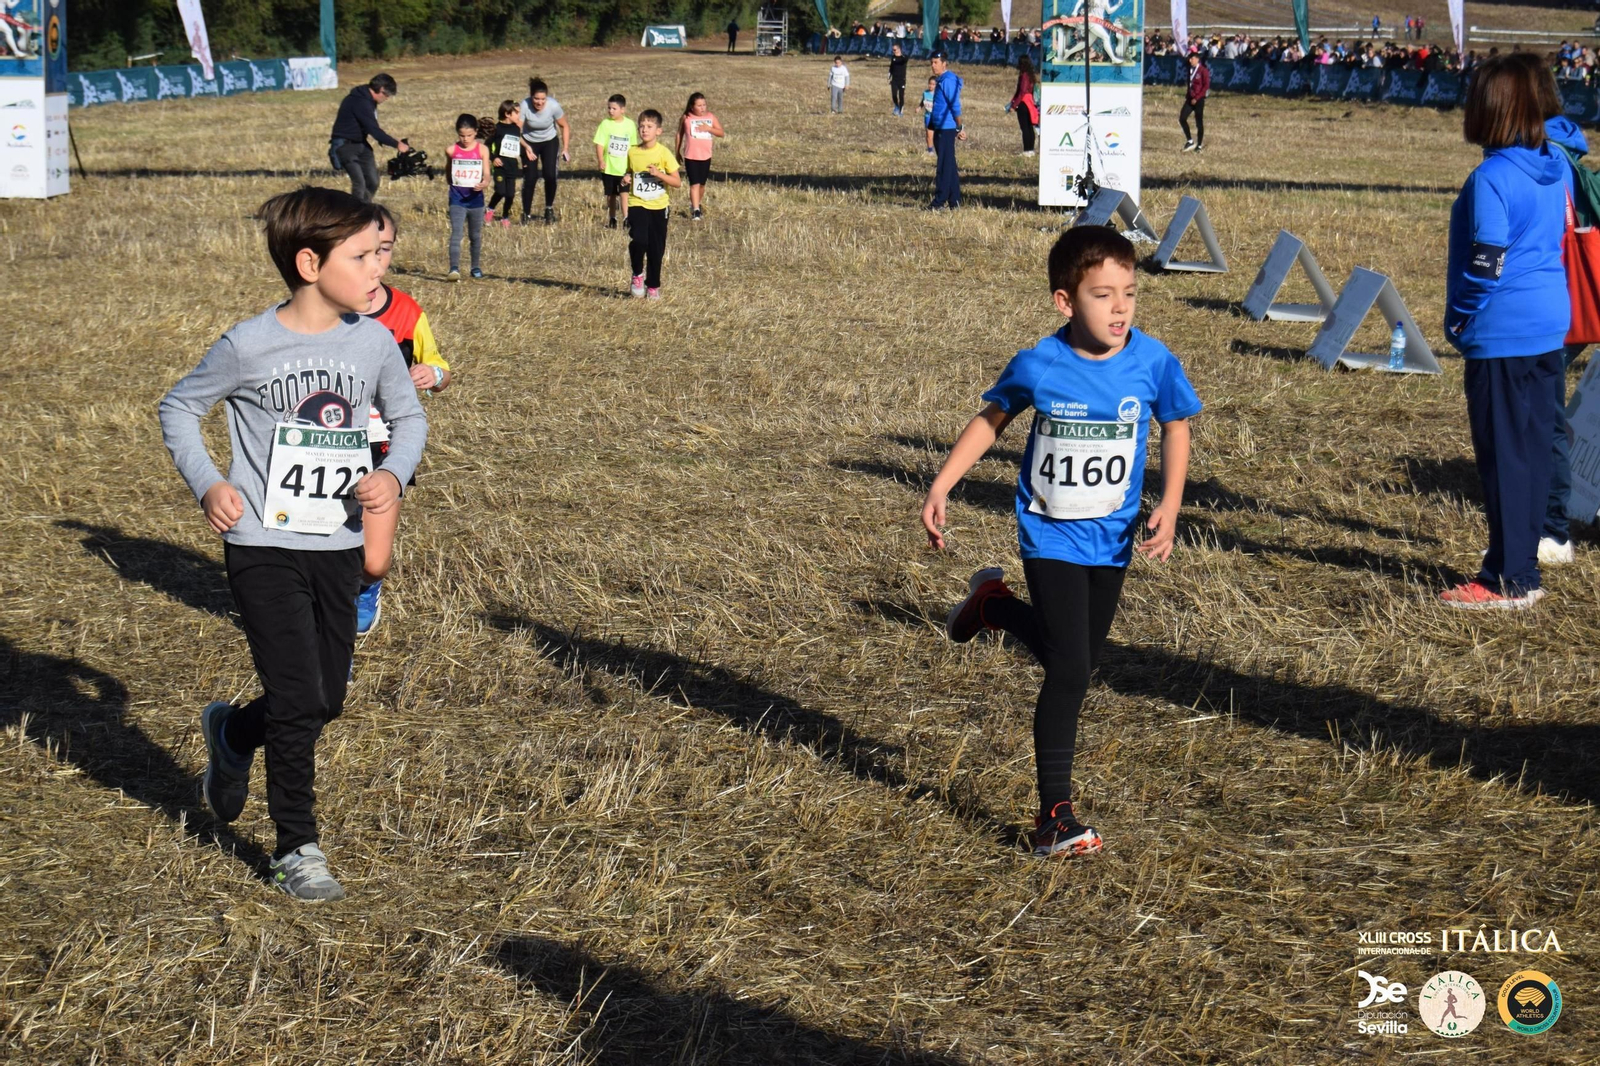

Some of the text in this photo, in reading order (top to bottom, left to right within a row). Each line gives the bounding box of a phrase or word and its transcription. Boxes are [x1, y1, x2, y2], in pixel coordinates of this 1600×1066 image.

[610, 142, 628, 152] 4323
[454, 170, 480, 179] 4472
[272, 358, 356, 376] AMERICAN
[324, 407, 342, 424] 25
[1056, 424, 1108, 437] ITÁLICA
[310, 432, 358, 446] ITÁLICA
[1039, 453, 1126, 487] 4160
